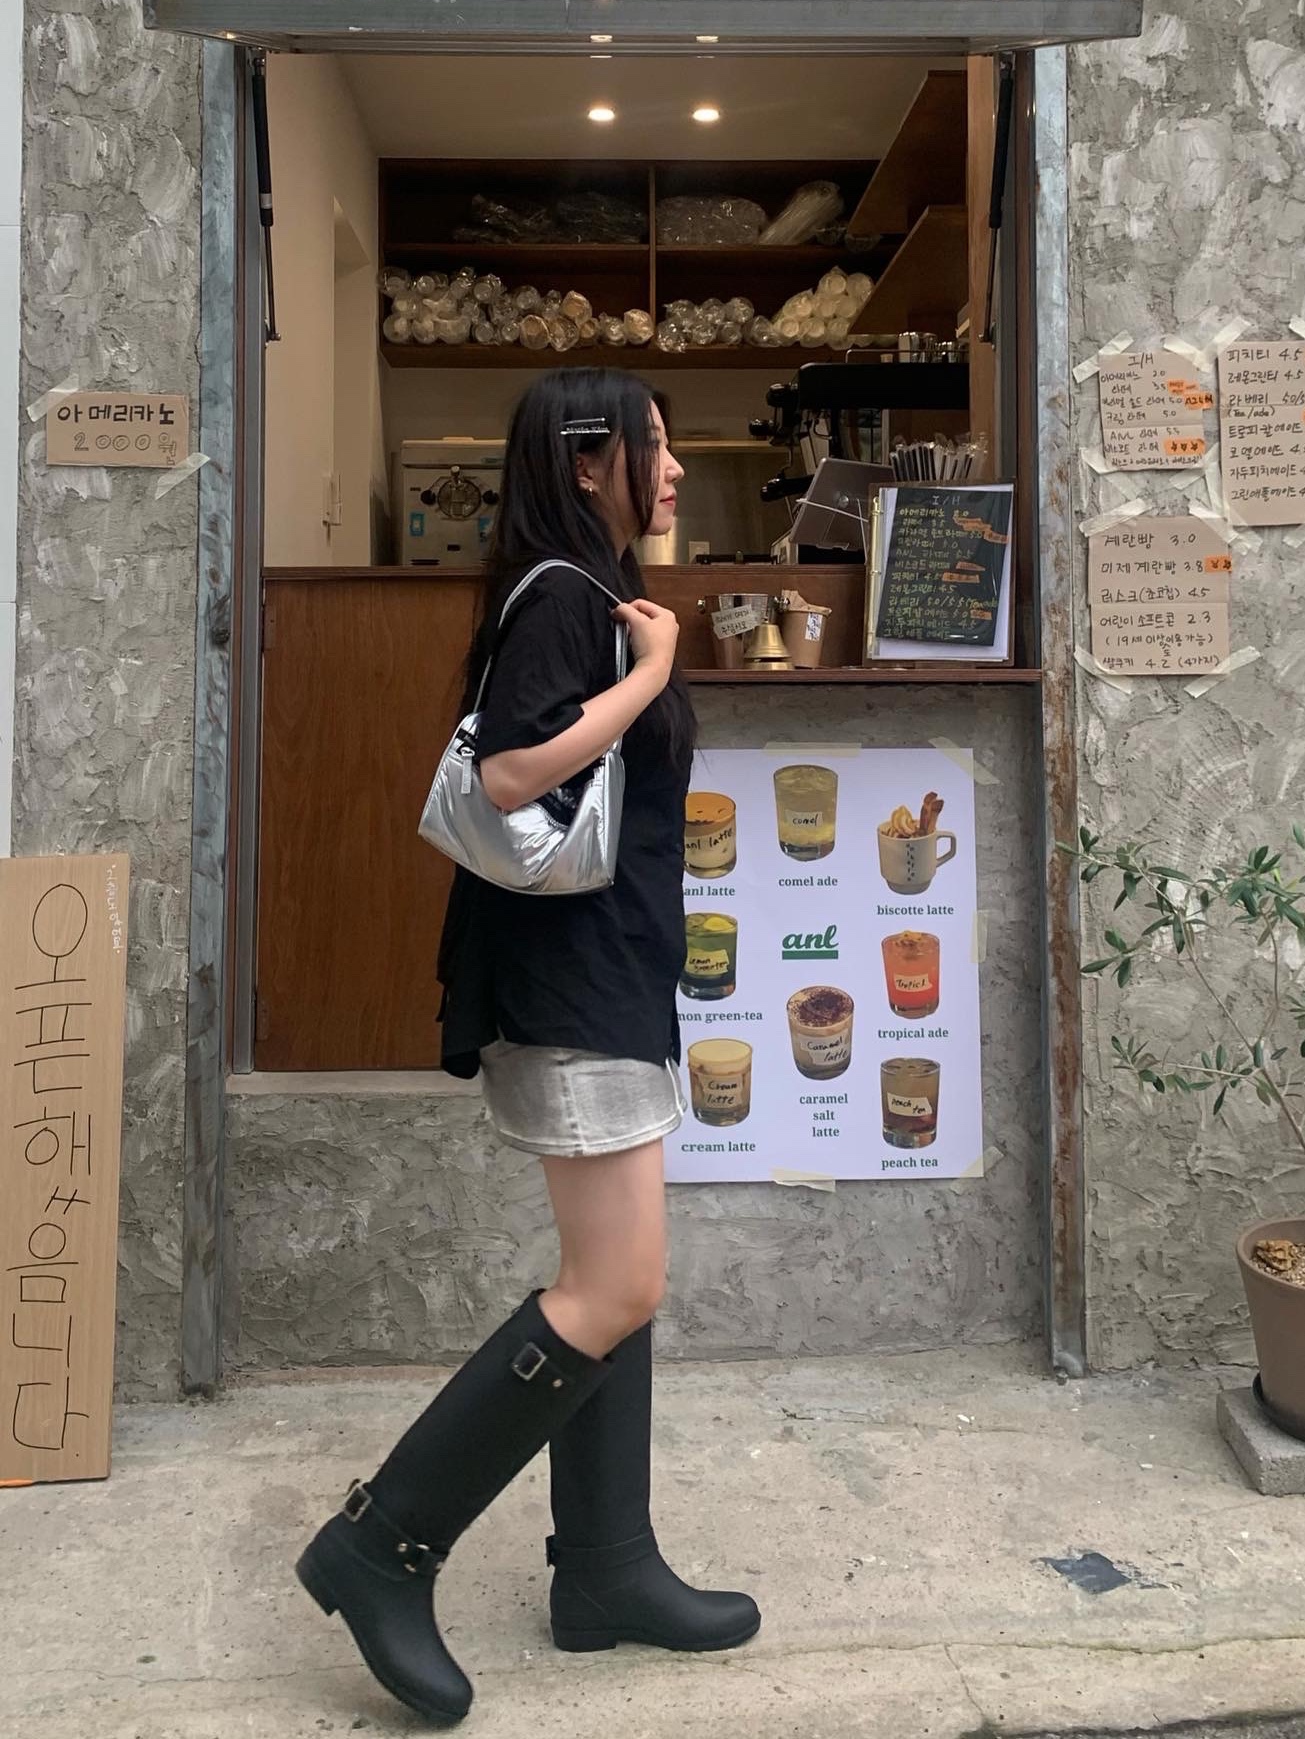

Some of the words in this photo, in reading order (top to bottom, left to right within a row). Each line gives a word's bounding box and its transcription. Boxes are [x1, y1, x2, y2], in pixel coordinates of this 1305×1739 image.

[1226, 348, 1270, 363] 피치티
[57, 402, 175, 426] 아메리카노
[1101, 532, 1156, 550] 계란빵
[1169, 532, 1197, 547] 3.0
[778, 875, 814, 888] comel
[816, 875, 839, 888] ade
[706, 885, 736, 897] latte
[876, 904, 924, 916] biscotte
[926, 903, 955, 916] latte
[781, 924, 839, 950] anl
[677, 1012, 702, 1021] mon
[704, 1010, 763, 1024] green-tea
[877, 1027, 925, 1041] tropical
[927, 1027, 950, 1038] ade
[798, 1092, 849, 1105] caramel
[812, 1109, 836, 1121] salt
[811, 1126, 840, 1138] latte
[680, 1142, 725, 1153] cream
[727, 1140, 757, 1152] latte
[881, 1156, 917, 1171] peach
[919, 1157, 939, 1168] tea
